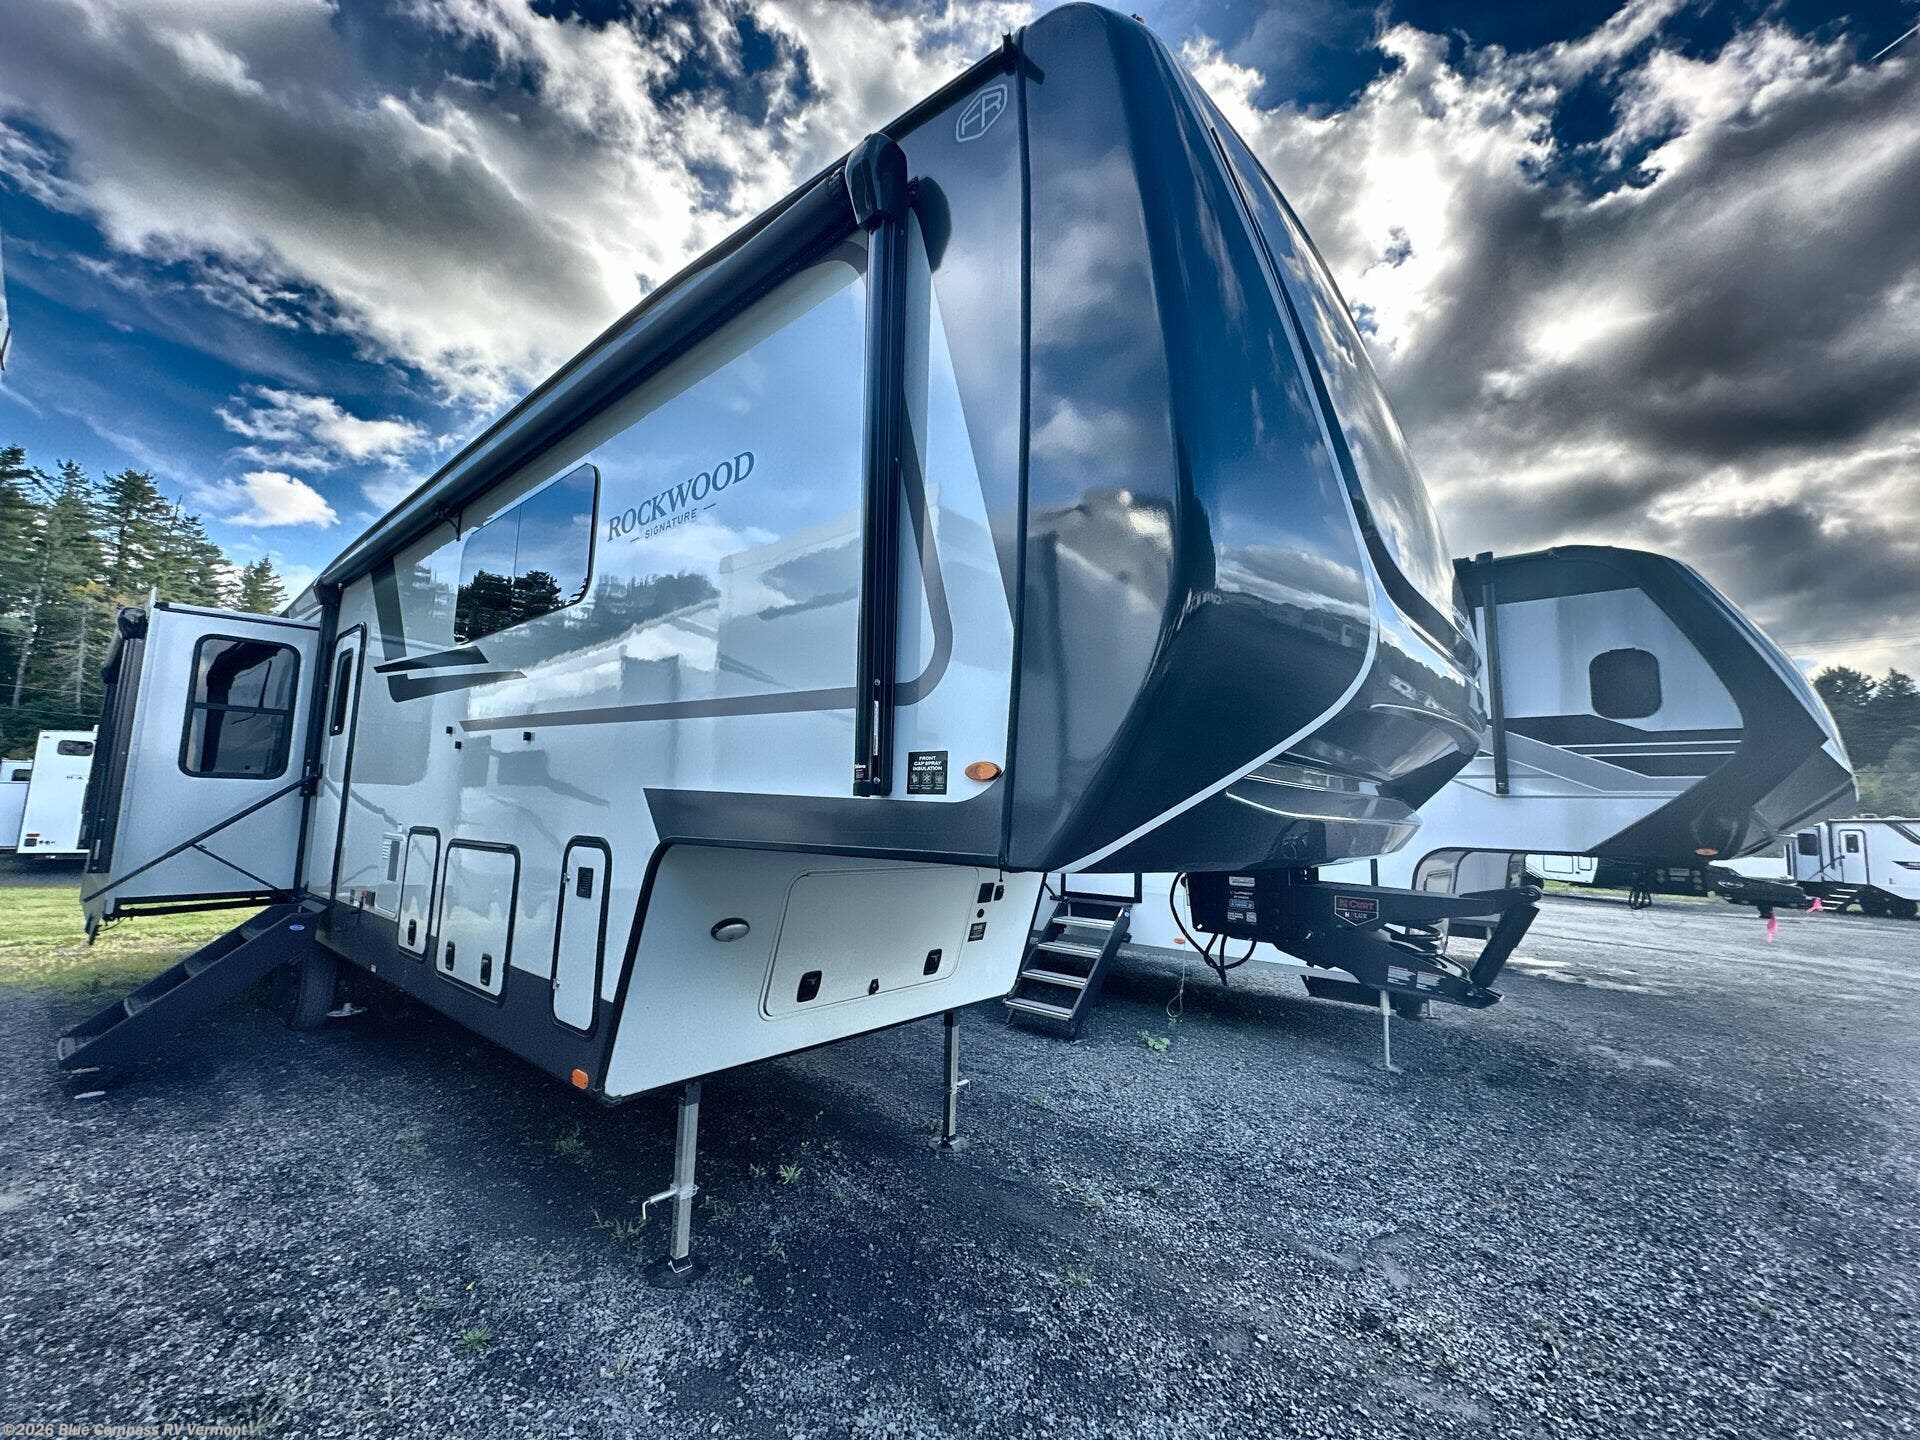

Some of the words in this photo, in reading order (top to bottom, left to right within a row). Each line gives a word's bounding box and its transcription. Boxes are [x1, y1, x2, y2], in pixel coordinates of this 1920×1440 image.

[607, 451, 755, 542] ROCKWOOD
[644, 508, 698, 539] SIGNATURE
[1344, 911, 1368, 919] HLUX
